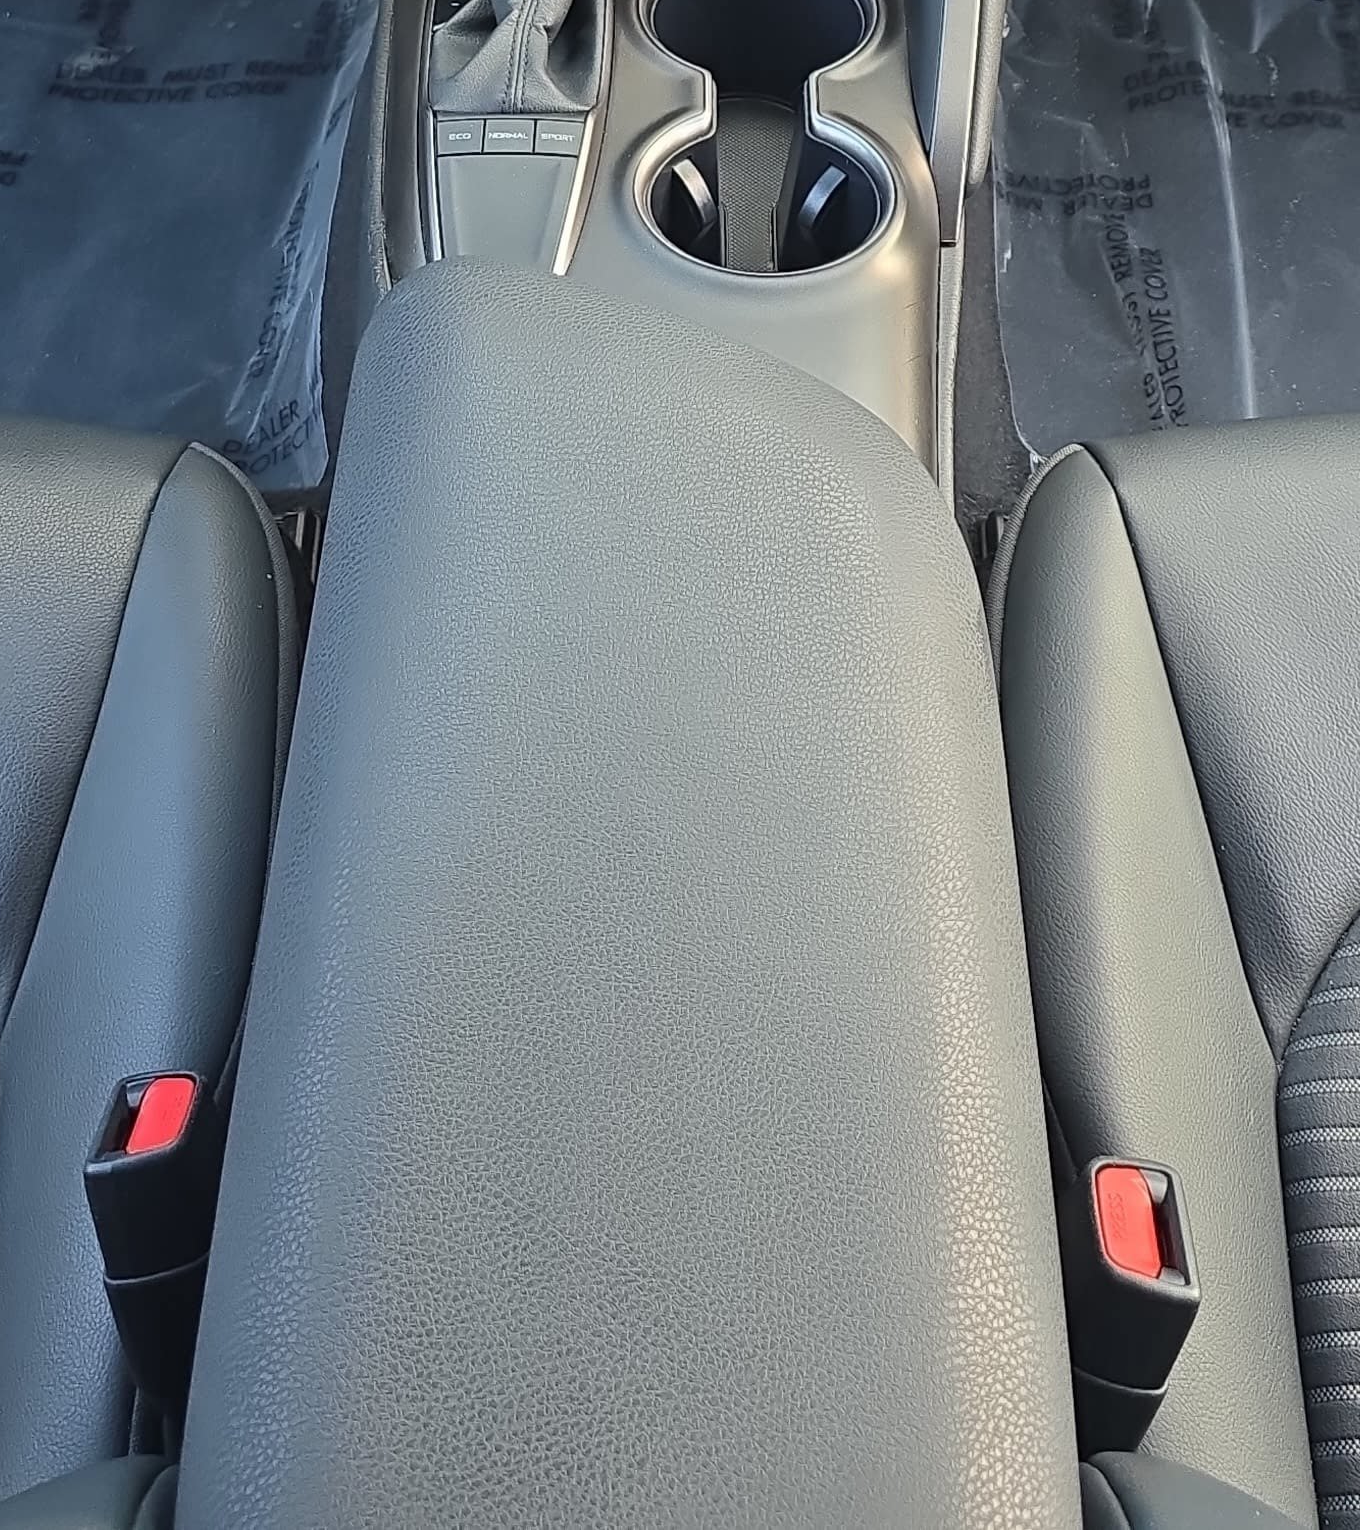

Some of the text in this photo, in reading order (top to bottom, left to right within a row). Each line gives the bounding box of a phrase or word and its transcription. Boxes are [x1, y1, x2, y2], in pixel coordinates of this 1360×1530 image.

[244, 60, 342, 77] REMOV
[1124, 61, 1206, 93] DEALE
[206, 80, 288, 100] COVER
[448, 132, 472, 141] ECO
[488, 131, 529, 141] NORMAL
[541, 132, 575, 142] SPORT
[1139, 247, 1169, 301] COVER
